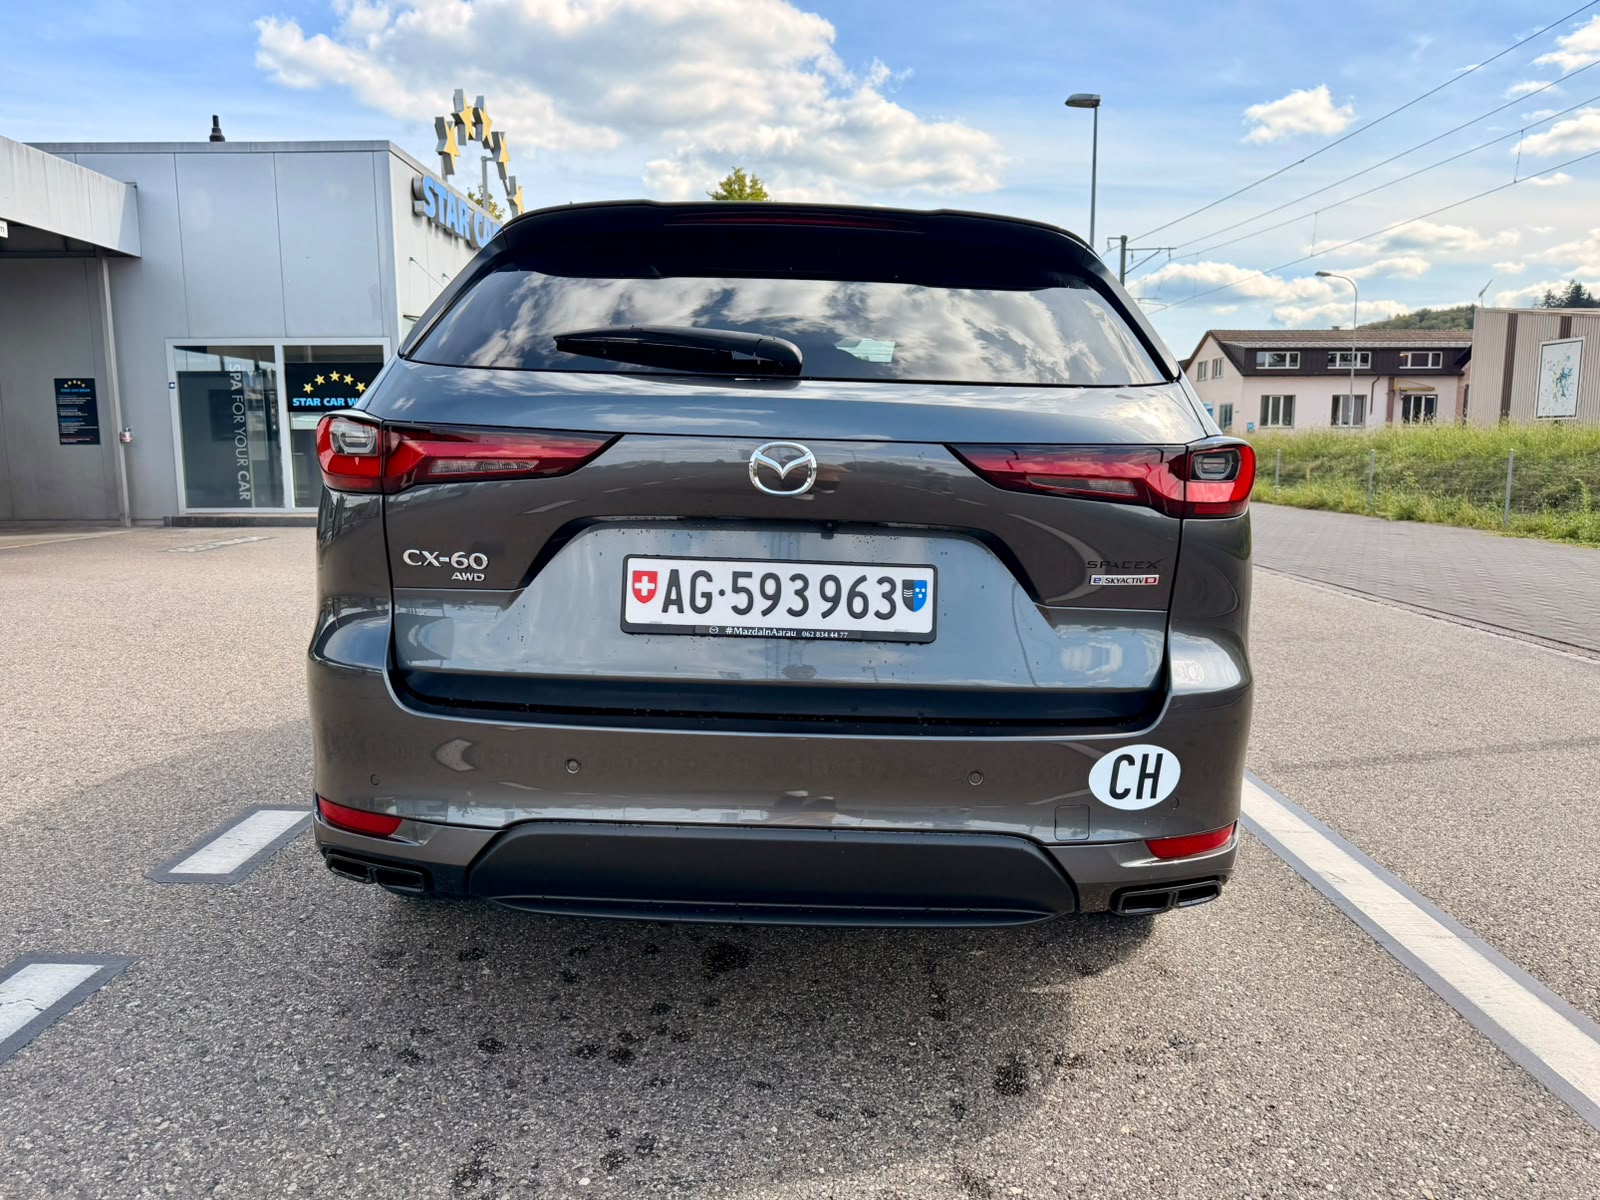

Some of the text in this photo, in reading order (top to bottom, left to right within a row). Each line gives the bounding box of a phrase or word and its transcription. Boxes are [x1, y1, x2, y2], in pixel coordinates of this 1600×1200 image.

[419, 175, 471, 241] STAR
[292, 397, 321, 407] STAR
[323, 397, 346, 407] CAR
[229, 364, 252, 501] SPA FOR YOUR CAR
[402, 549, 489, 570] CX-60
[1086, 559, 1162, 569] SPACEX
[451, 572, 485, 582] AWD
[1104, 577, 1145, 585] SKYACTIV
[801, 630, 815, 638] 062
[1109, 753, 1164, 800] CH
